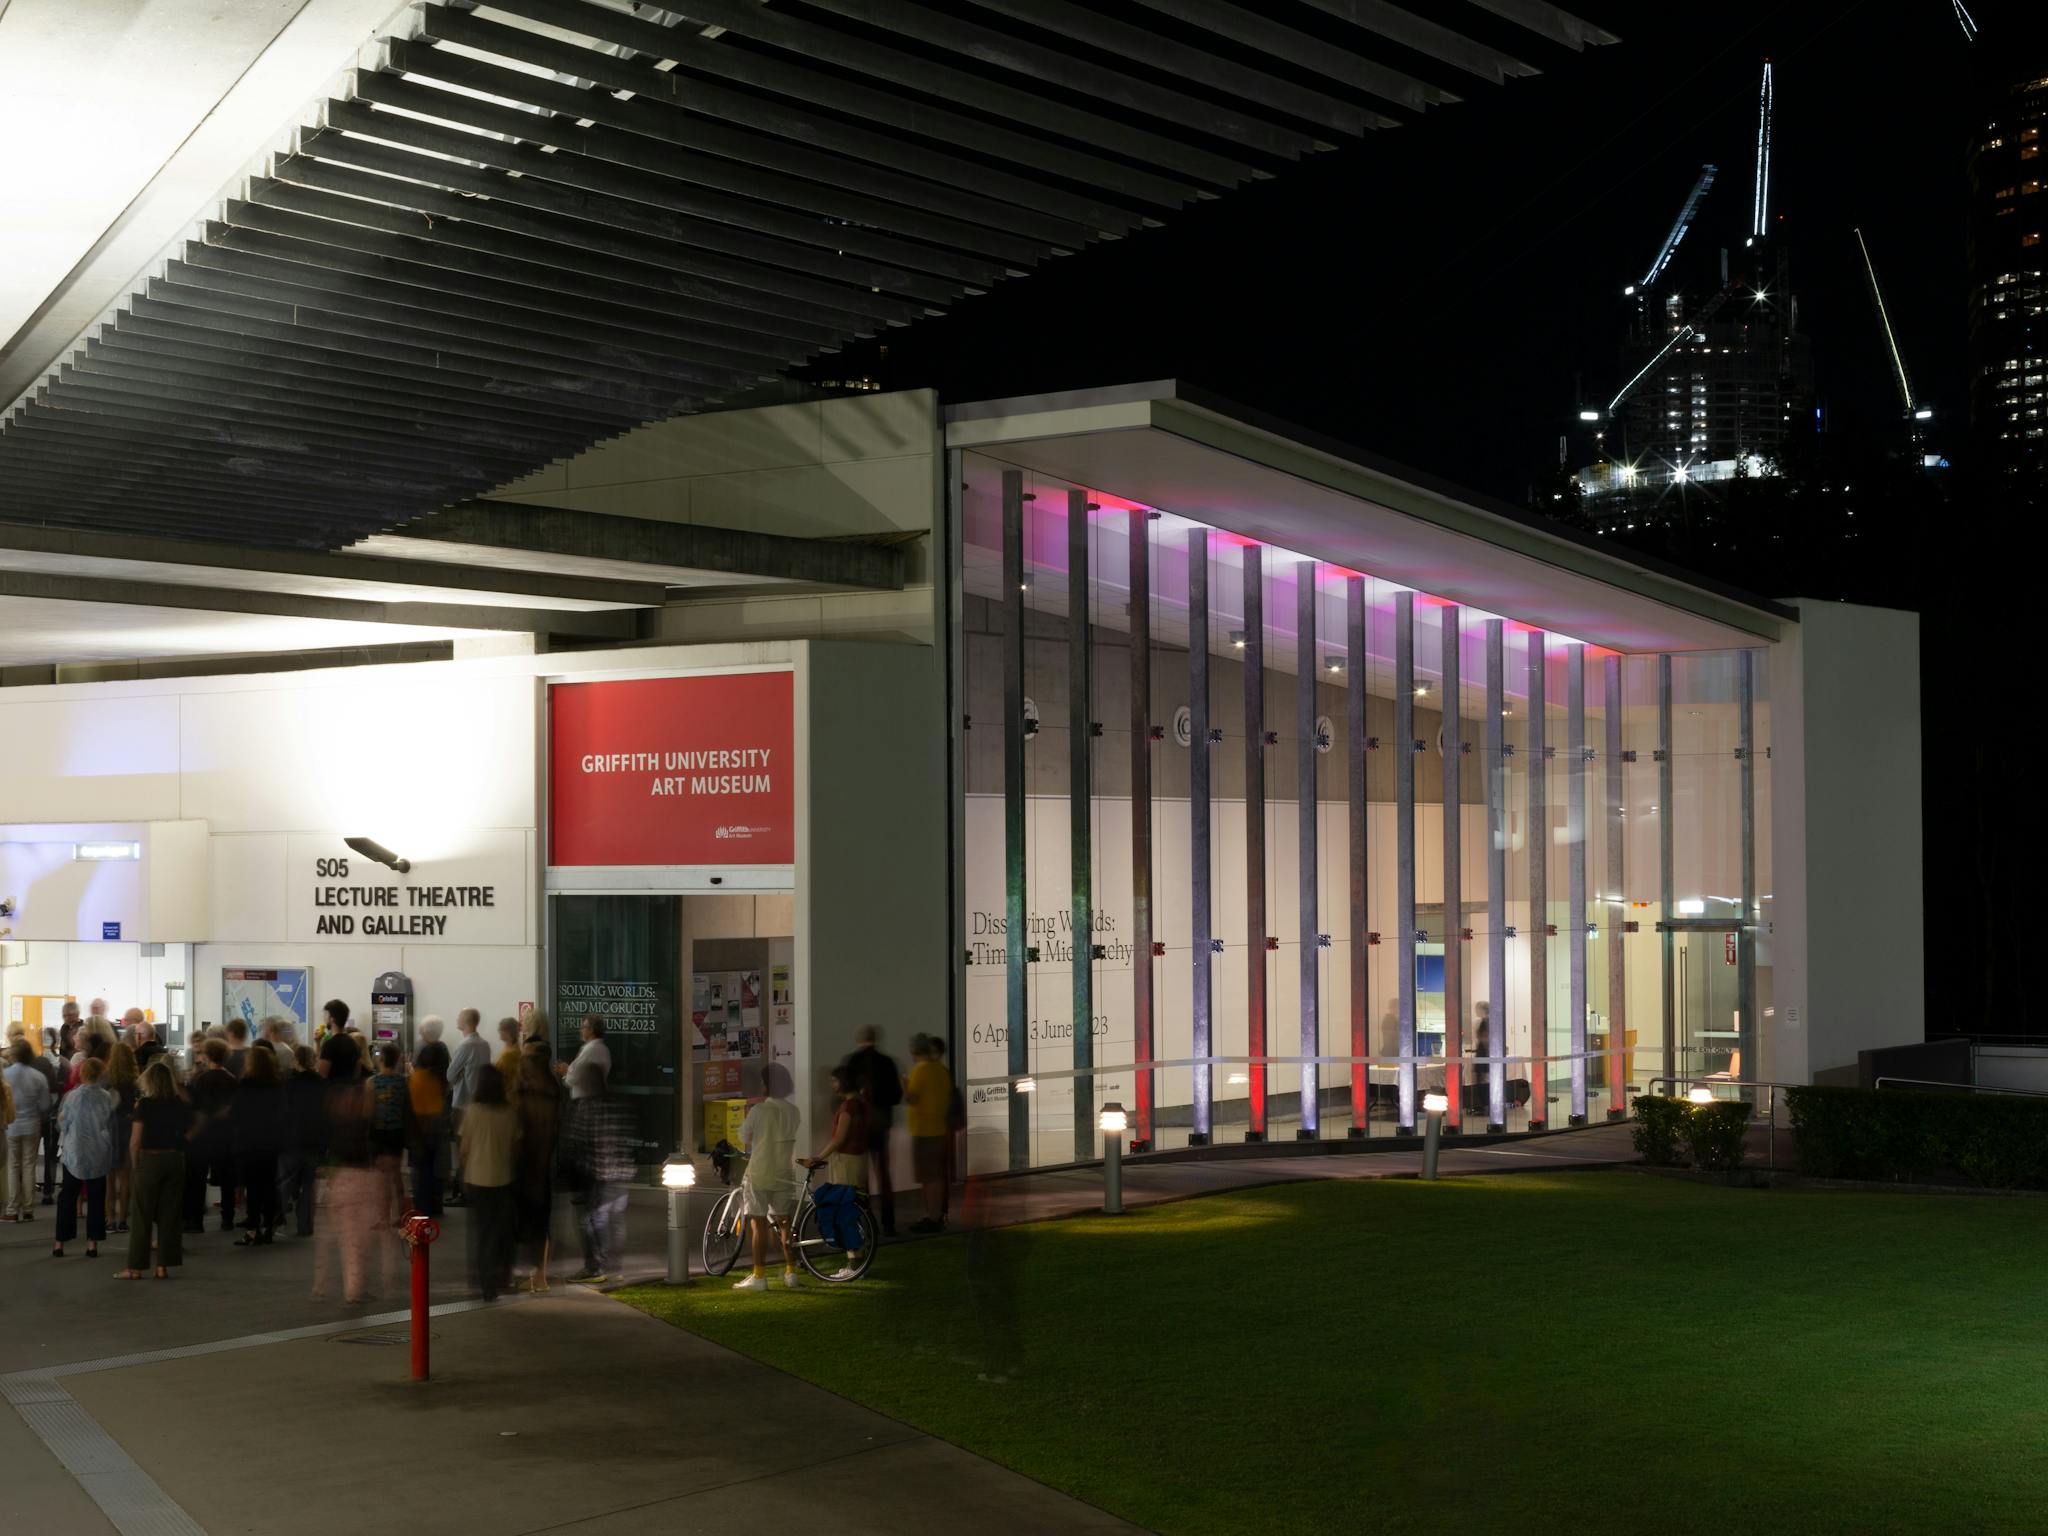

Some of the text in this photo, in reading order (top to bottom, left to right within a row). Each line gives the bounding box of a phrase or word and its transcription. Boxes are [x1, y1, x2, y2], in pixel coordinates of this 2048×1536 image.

[581, 749, 771, 773] GRIFFITH UNIVERSITY
[651, 774, 771, 796] ART MUSEUM
[315, 886, 495, 907] LECTURE THEATRE
[316, 915, 447, 935] AND GALLERY
[972, 909, 1116, 940] Dissving Wlds:
[972, 942, 1007, 965] Tim
[607, 985, 656, 999] WORLDS:
[564, 1001, 587, 1013] AND
[588, 1001, 610, 1014] MIC
[610, 1002, 656, 1015] GRUCHY
[630, 1019, 656, 1031] 2023
[972, 1023, 982, 1044] 6
[1030, 1020, 1039, 1040] 3
[1041, 1019, 1073, 1040] June
[1090, 1015, 1109, 1036] 23
